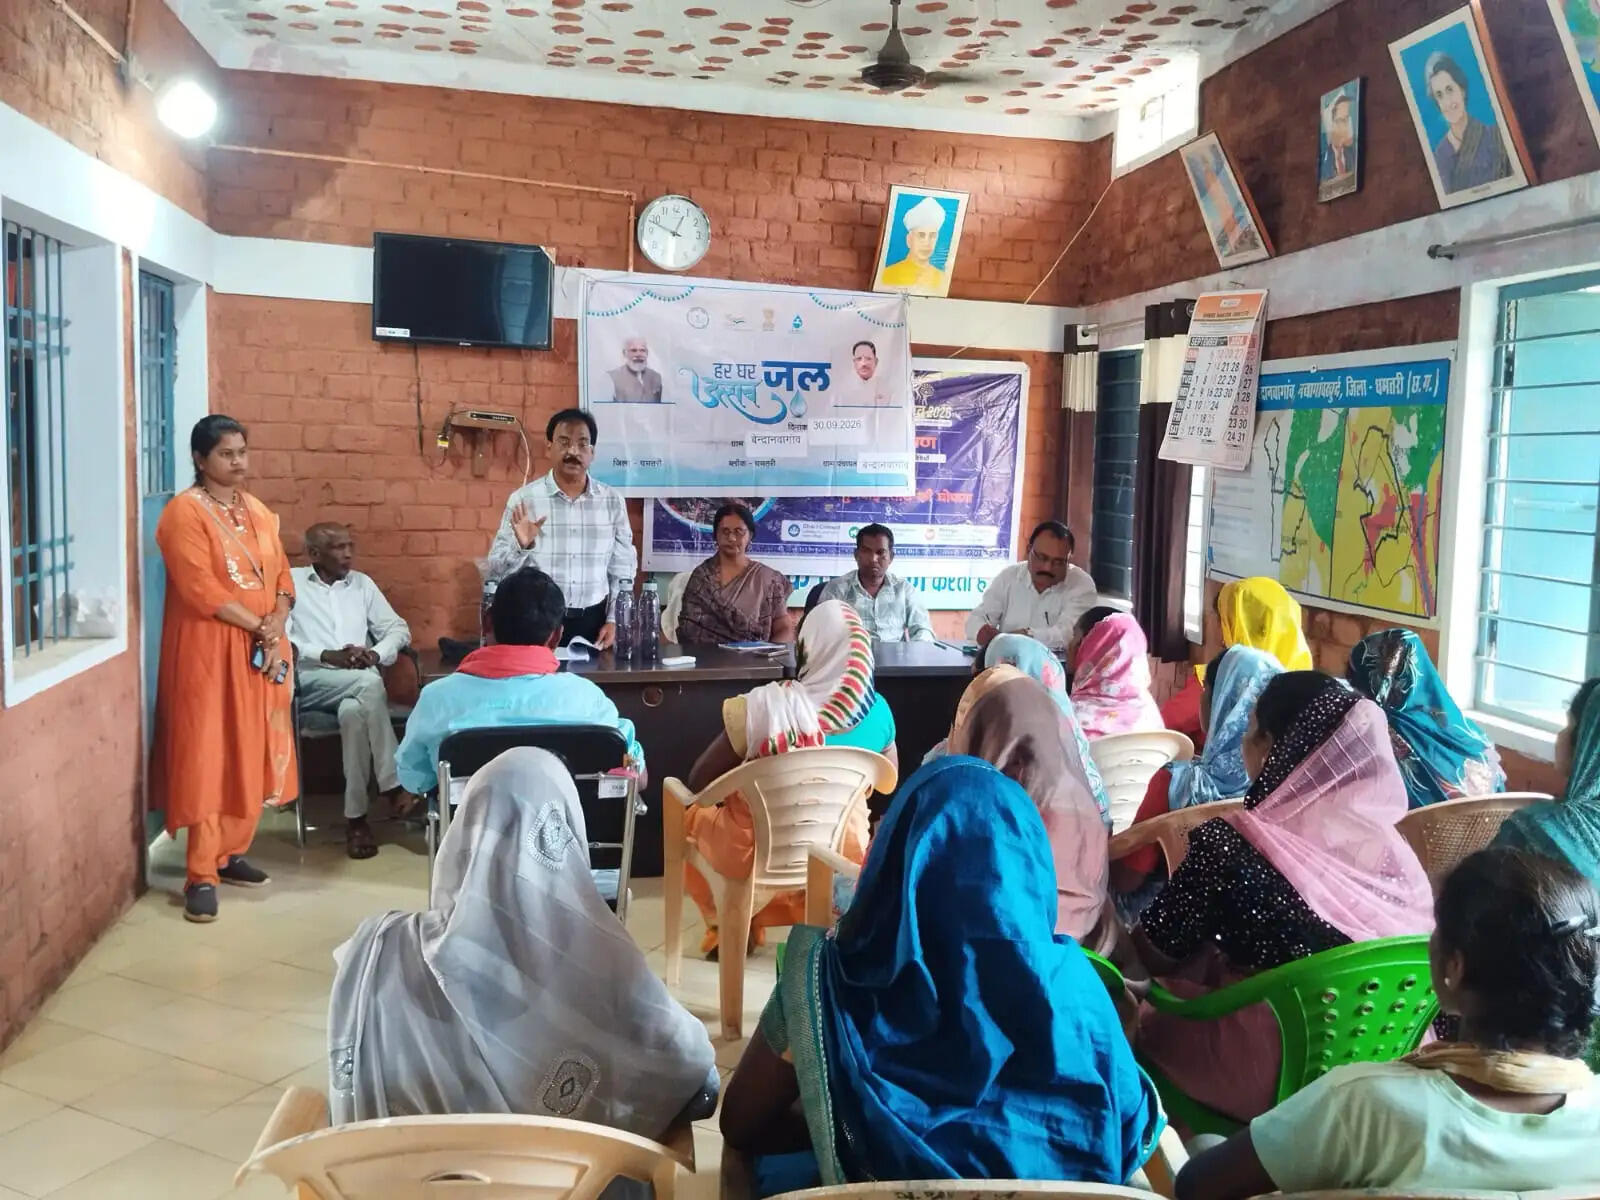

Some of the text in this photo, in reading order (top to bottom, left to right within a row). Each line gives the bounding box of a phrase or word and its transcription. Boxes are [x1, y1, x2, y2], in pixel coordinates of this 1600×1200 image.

[1221, 361, 1230, 373] 21
[1231, 361, 1240, 373] 28
[713, 360, 832, 392] हर घर जल
[1217, 374, 1226, 385] 22
[1227, 375, 1237, 386] 29
[1243, 379, 1252, 389] 27
[1345, 375, 1368, 397] जिला
[1375, 371, 1405, 396] धमतरी
[1214, 387, 1222, 398] 23
[1223, 388, 1233, 398] 30
[1241, 391, 1251, 403] 28
[1210, 401, 1219, 411] 24
[1230, 405, 1239, 416] 22
[1228, 418, 1248, 430] 23 30
[1227, 431, 1246, 442] 24 31
